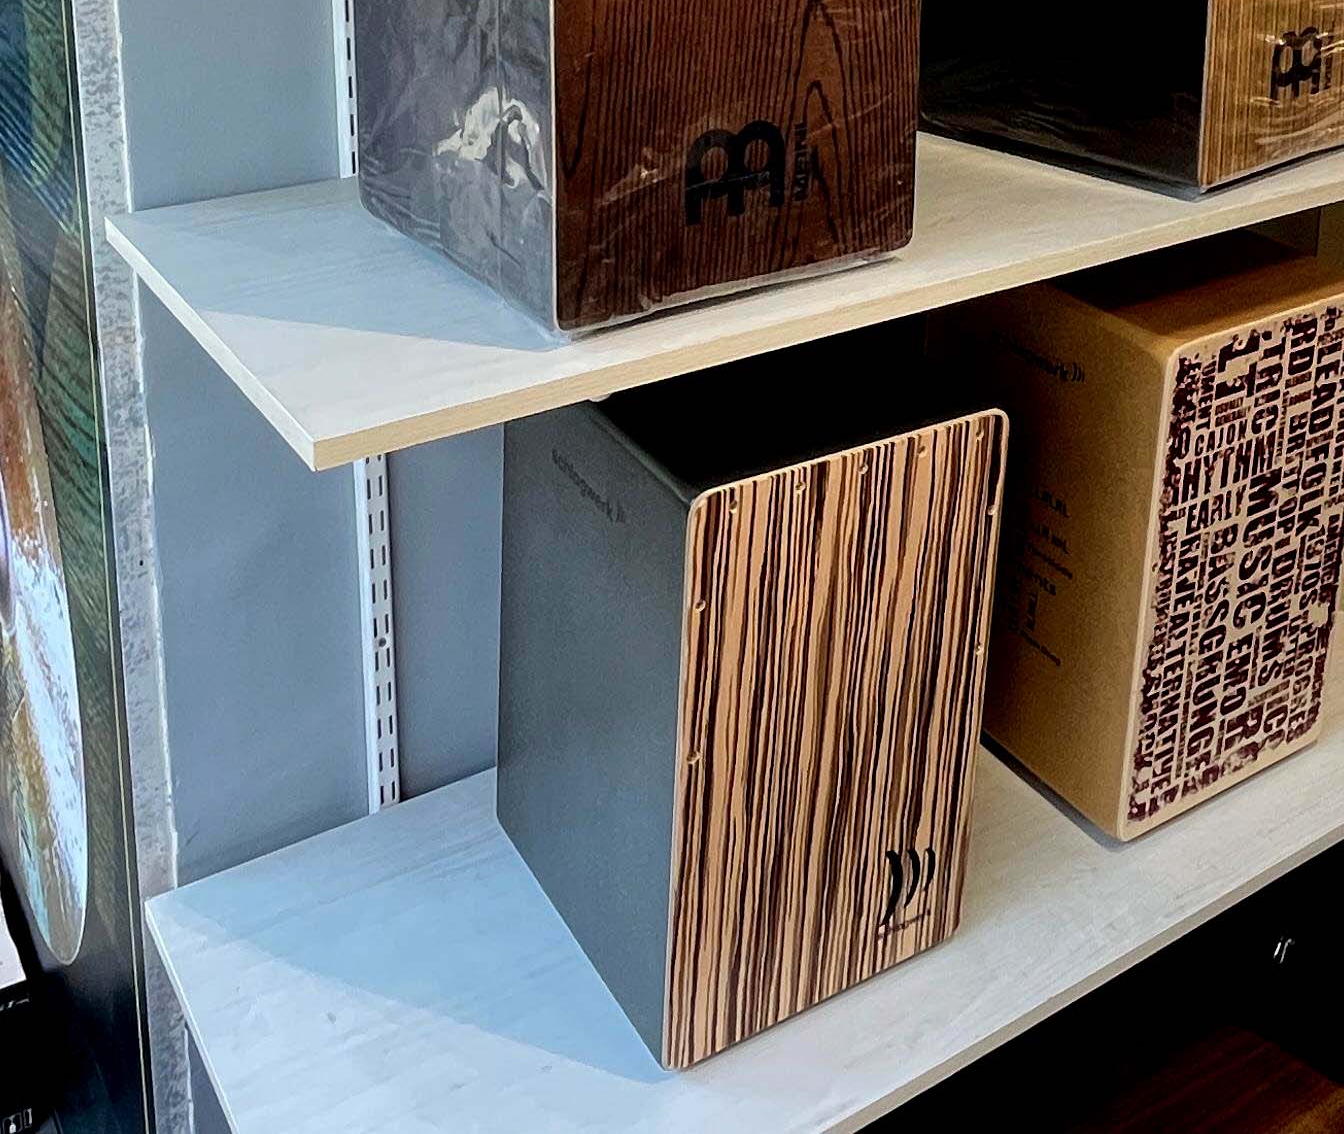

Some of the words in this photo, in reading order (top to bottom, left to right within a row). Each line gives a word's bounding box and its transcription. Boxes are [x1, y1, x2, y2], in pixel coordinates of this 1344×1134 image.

[1308, 341, 1341, 433] LEAD
[1194, 419, 1247, 456] CAJON
[1185, 484, 1246, 534] EARLY
[1295, 442, 1329, 535] FOLK
[1233, 468, 1281, 627] MUSIC
[1258, 550, 1296, 685] DRUMS
[1220, 633, 1252, 714] EMO
